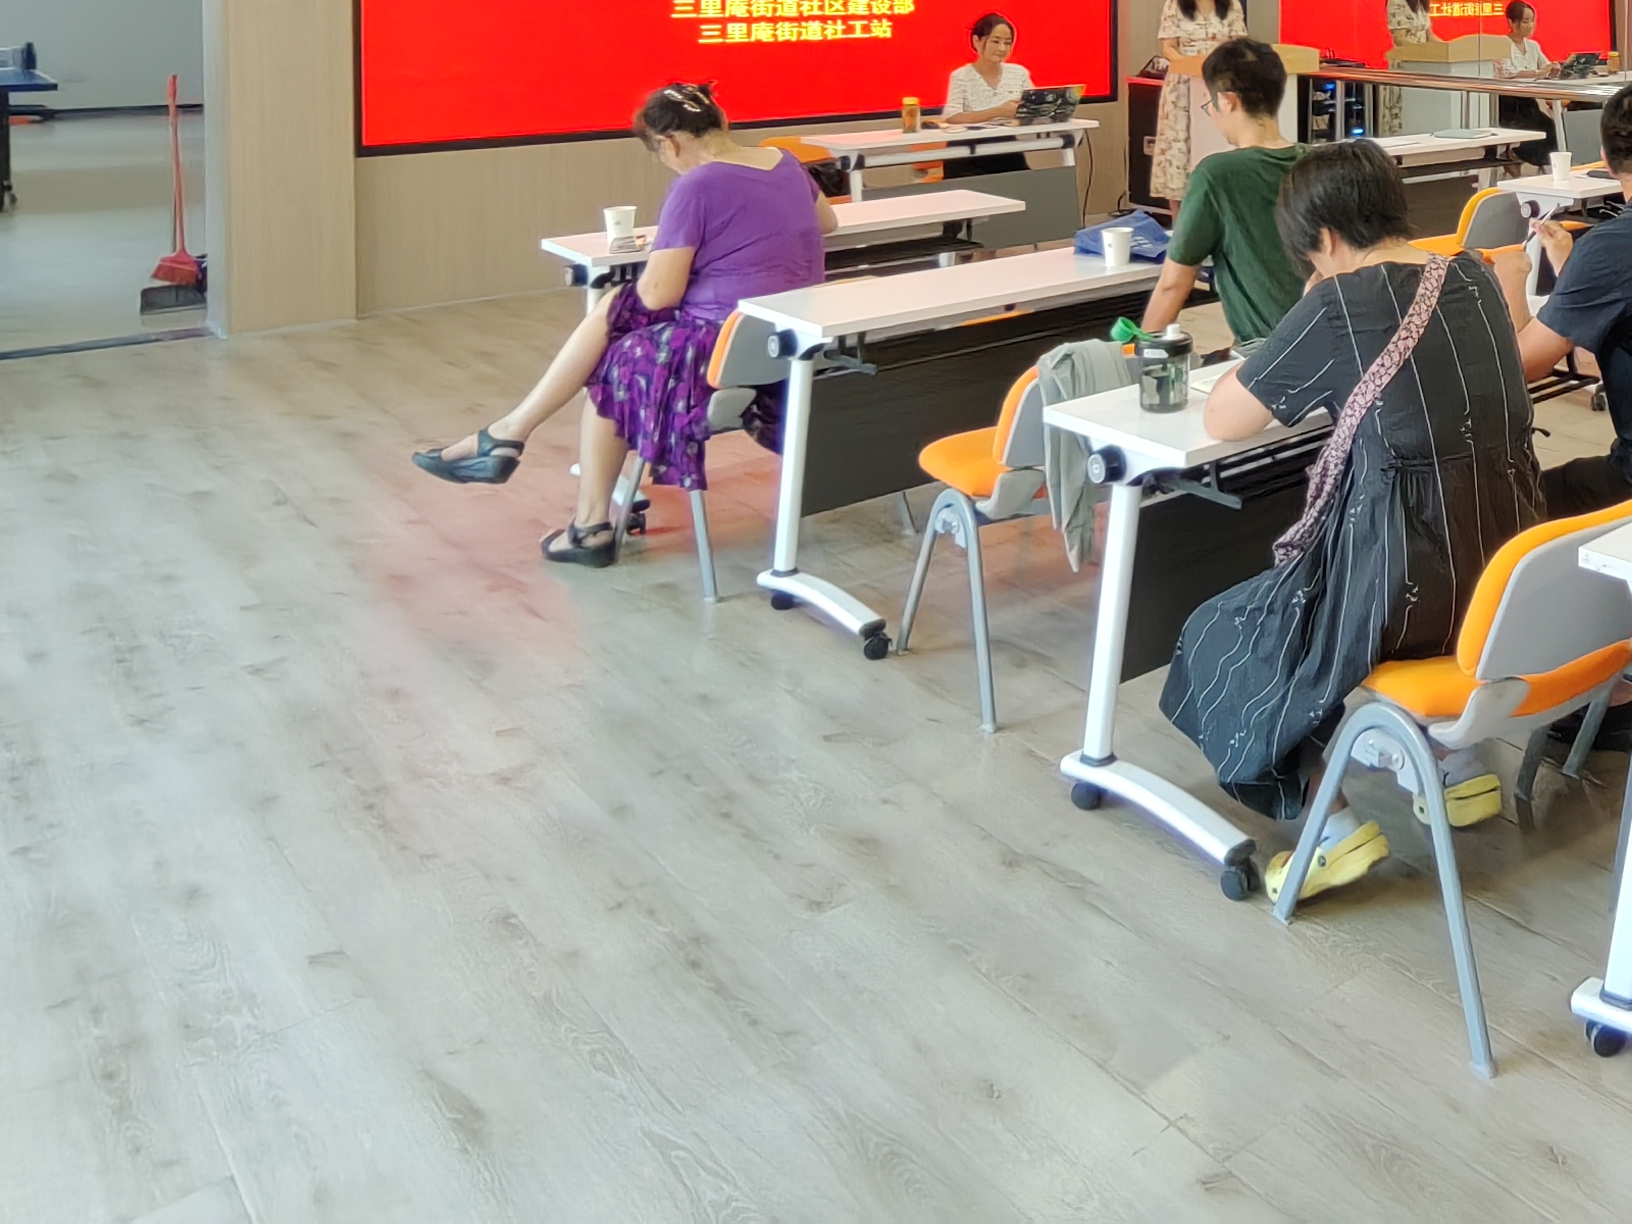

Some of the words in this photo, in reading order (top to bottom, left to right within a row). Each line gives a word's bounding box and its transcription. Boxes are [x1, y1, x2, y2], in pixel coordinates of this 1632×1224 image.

[698, 19, 893, 43] 三里庵街道社工站
